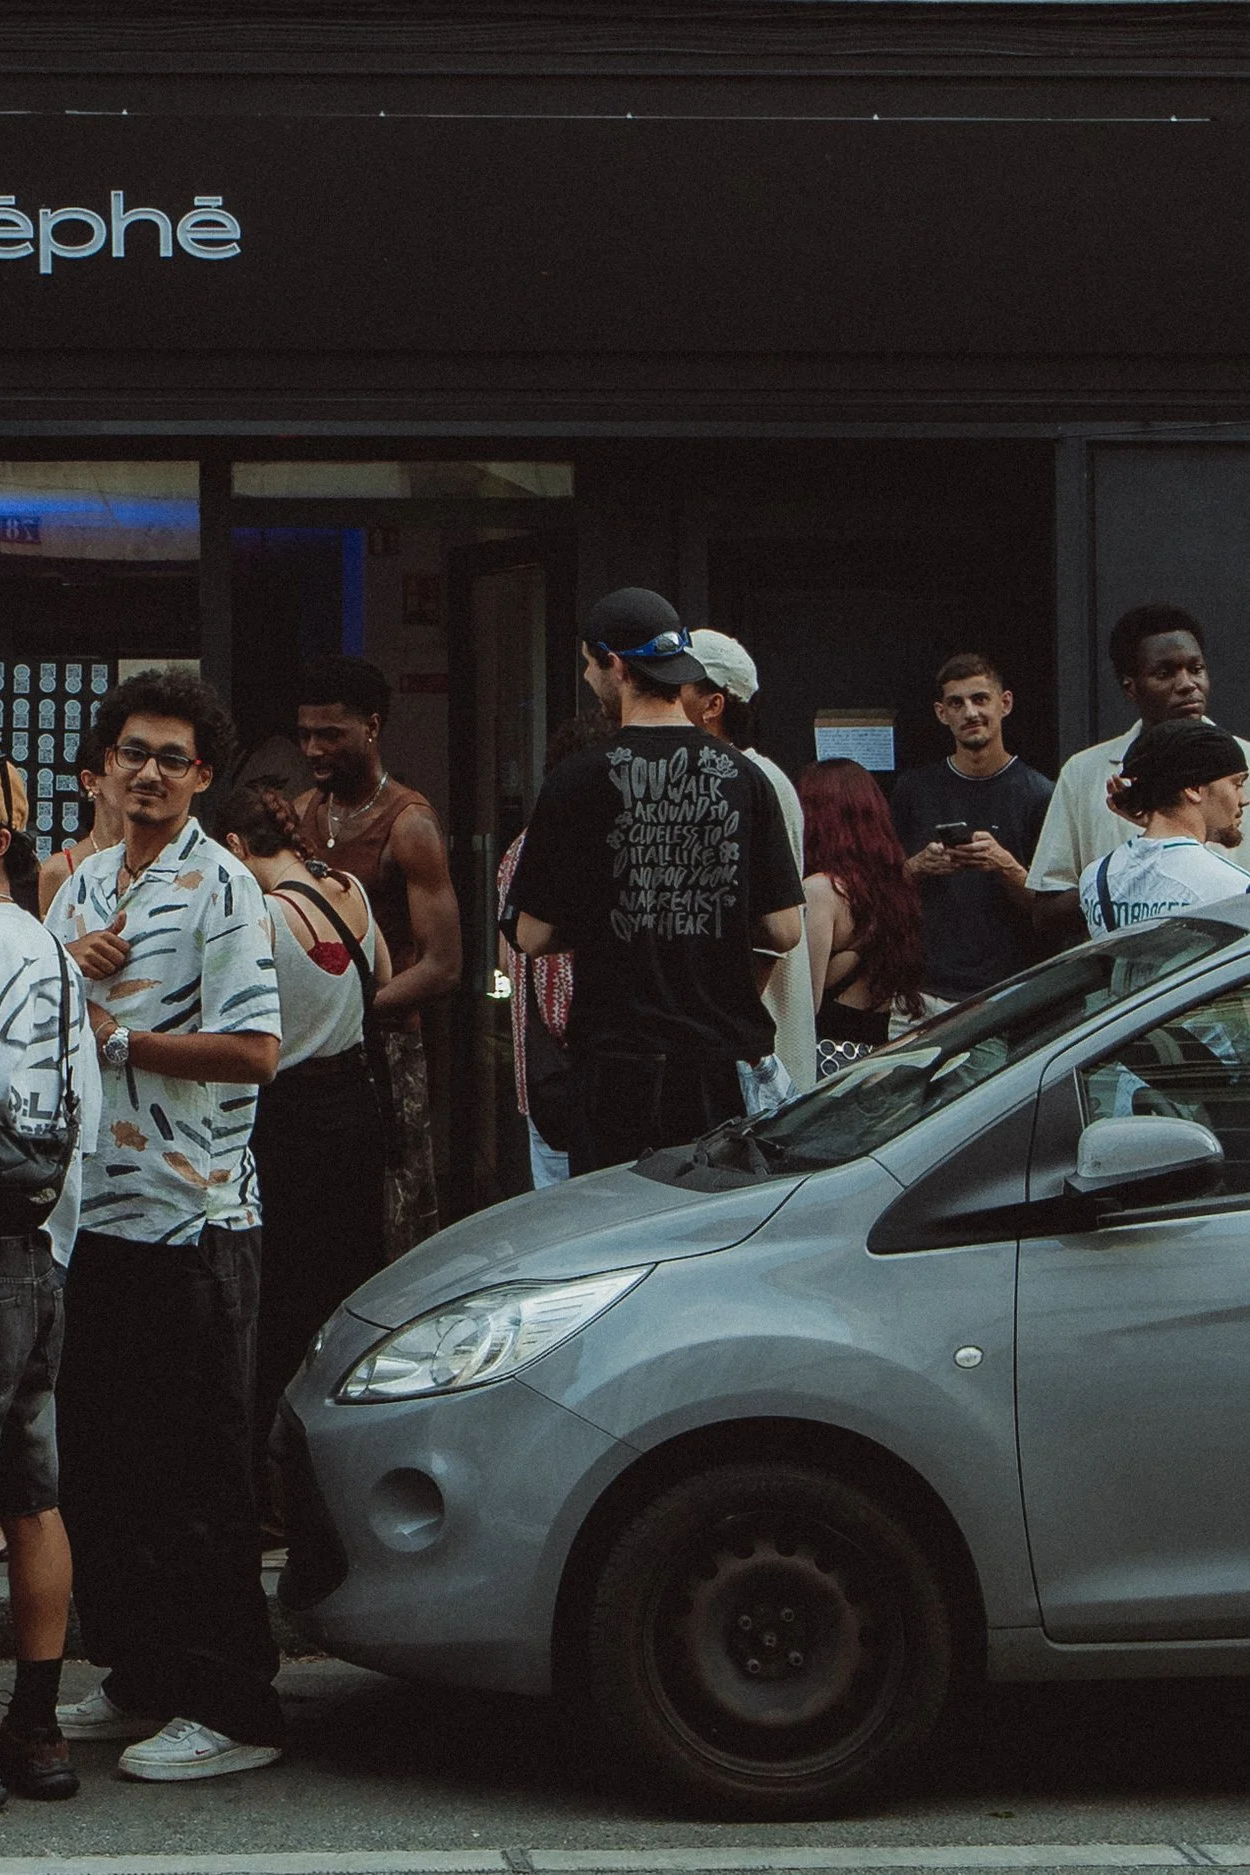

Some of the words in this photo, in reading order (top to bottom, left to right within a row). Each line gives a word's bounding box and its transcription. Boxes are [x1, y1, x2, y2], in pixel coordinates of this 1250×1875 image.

[608, 757, 667, 809] YOU
[667, 774, 724, 802] WALK
[635, 797, 710, 823] AROUND
[629, 823, 700, 849] CLUELESS
[704, 825, 722, 847] TO
[674, 844, 716, 866] LIKE
